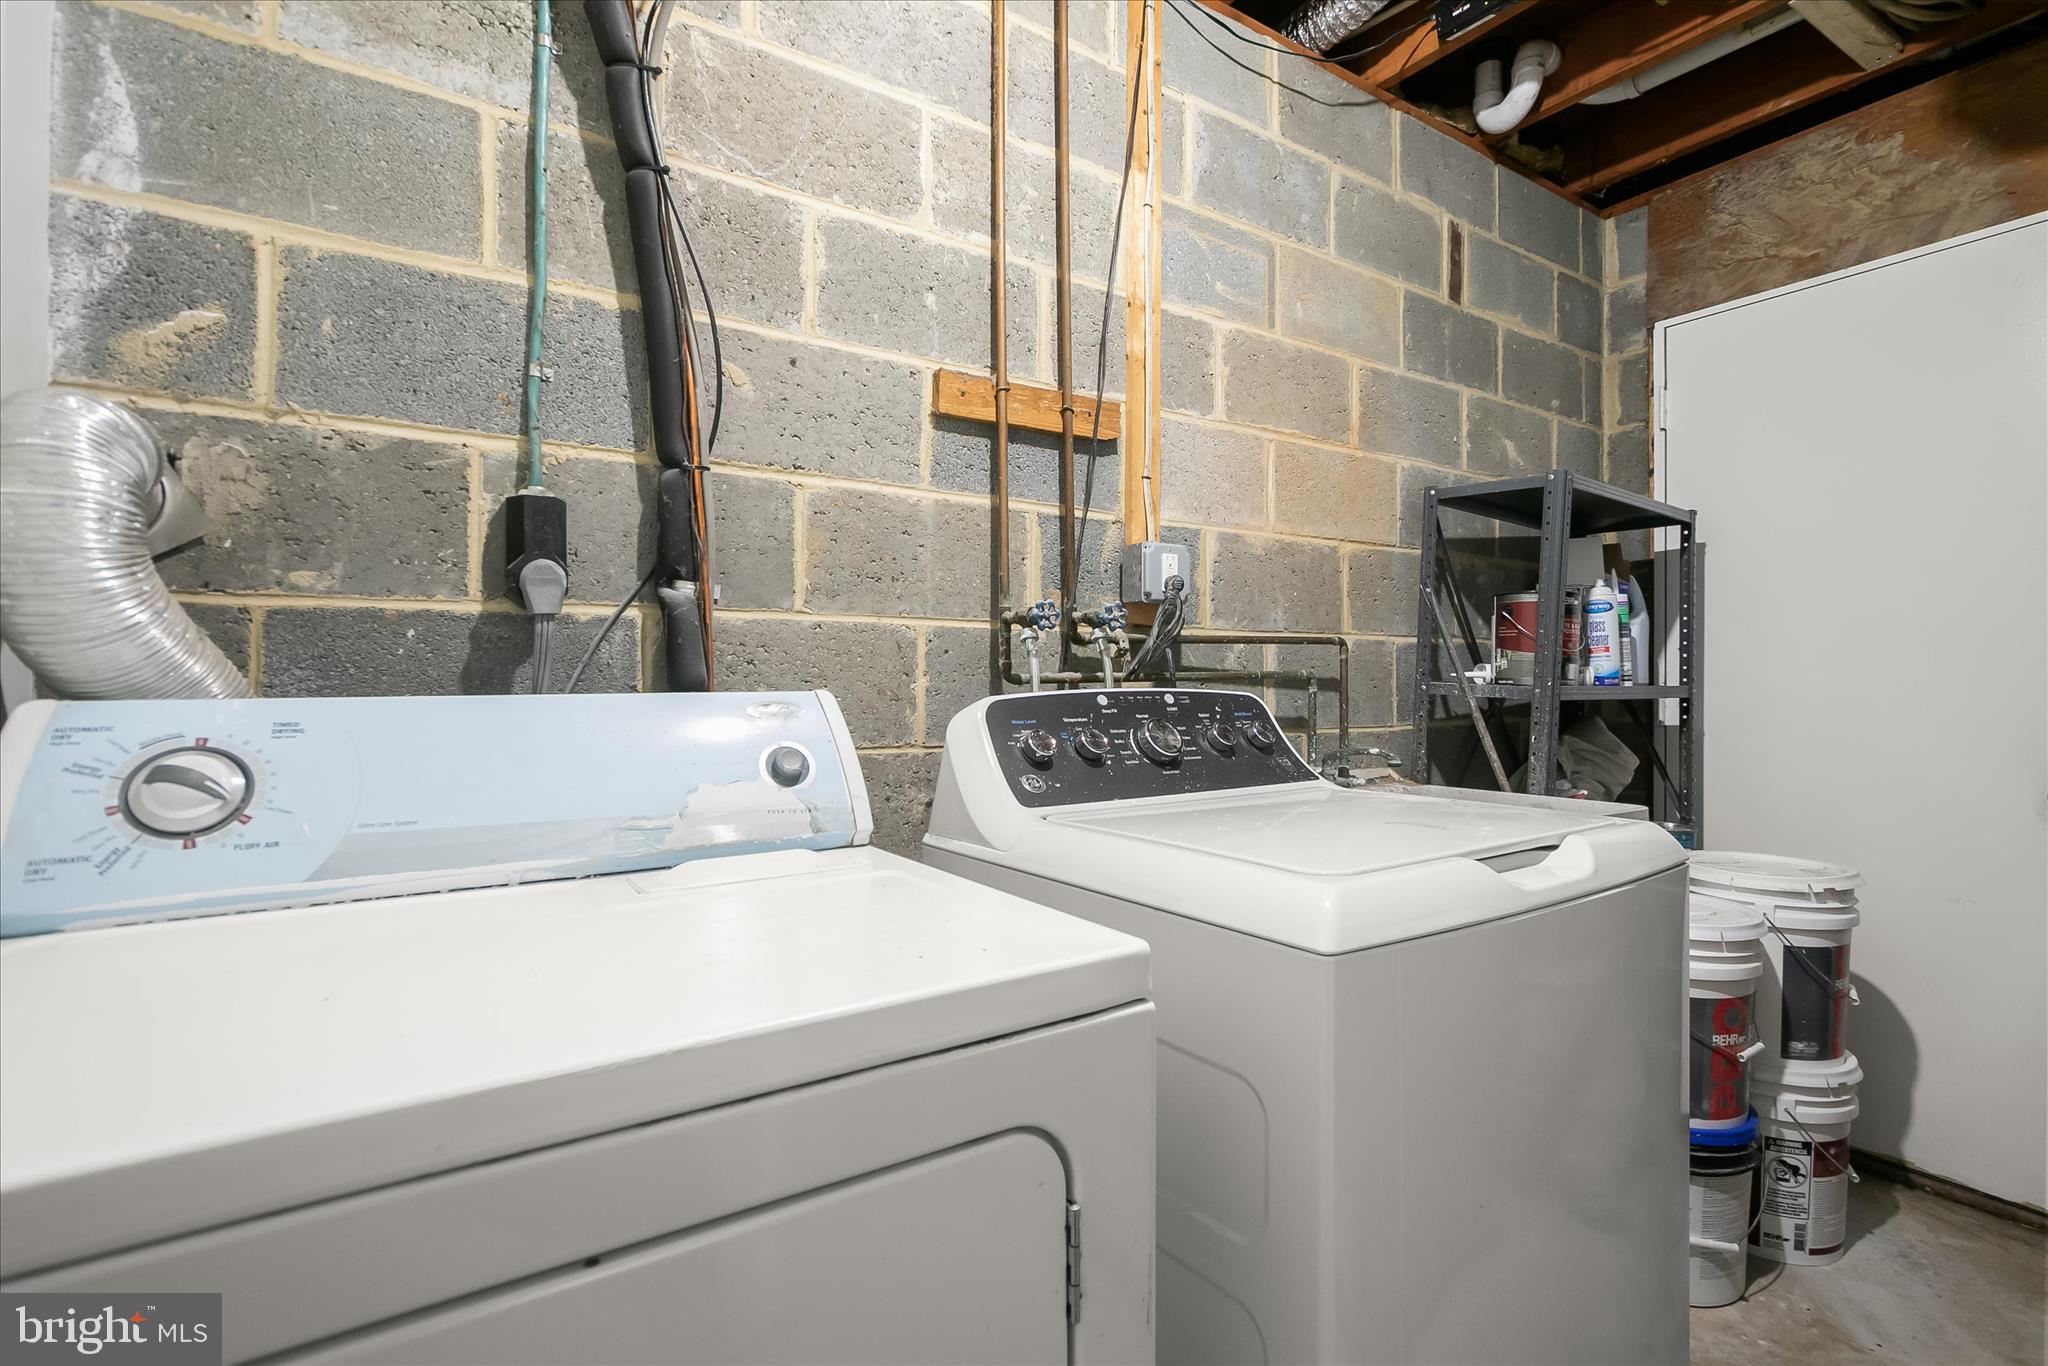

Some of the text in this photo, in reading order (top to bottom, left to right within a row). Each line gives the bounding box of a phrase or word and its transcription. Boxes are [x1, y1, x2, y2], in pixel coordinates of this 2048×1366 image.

[1589, 619, 1606, 633] glass
[25, 855, 93, 867] AUTOMATIC
[1712, 1033, 1738, 1047] BEHR
